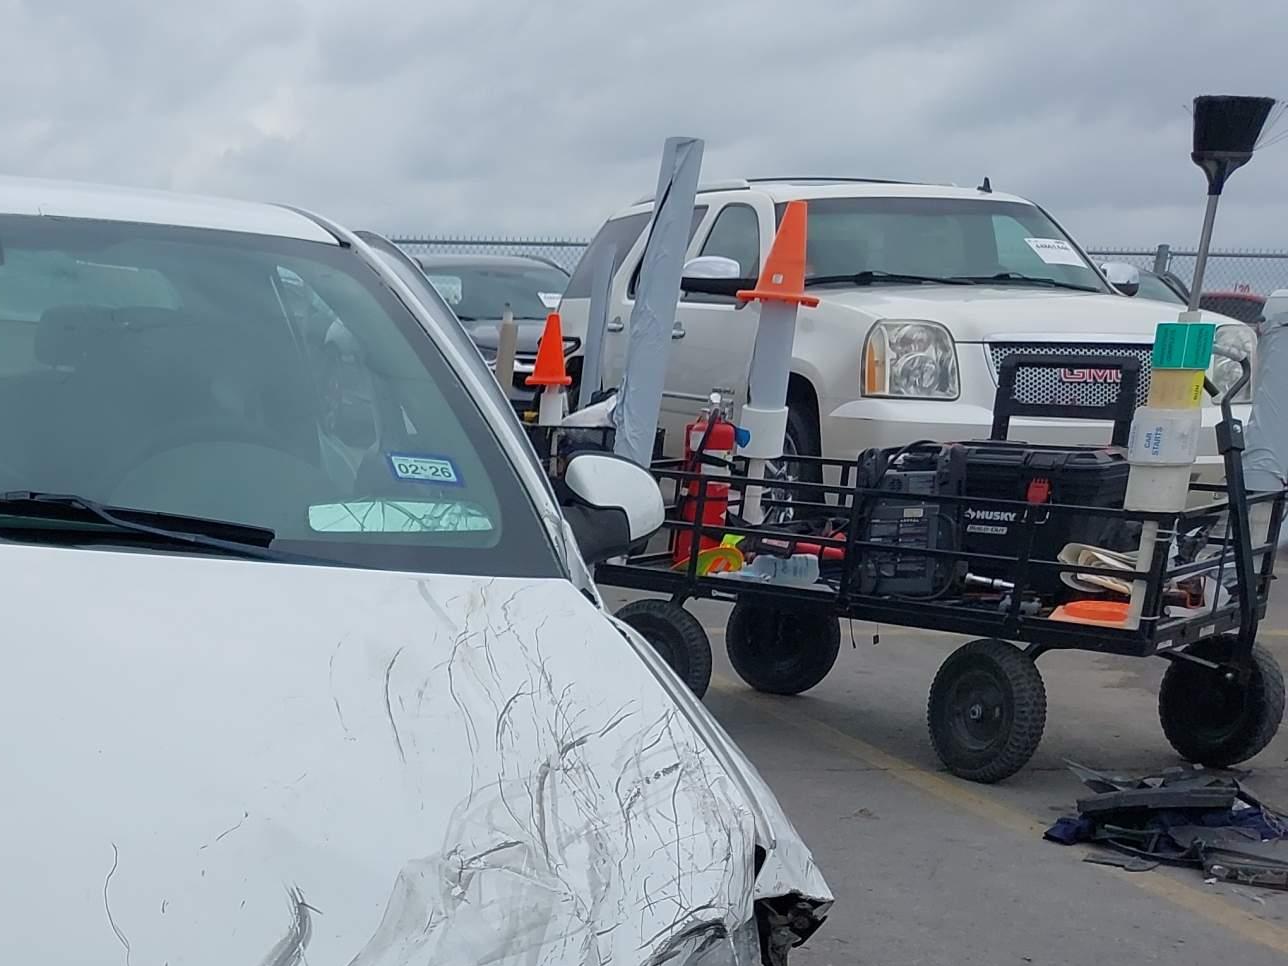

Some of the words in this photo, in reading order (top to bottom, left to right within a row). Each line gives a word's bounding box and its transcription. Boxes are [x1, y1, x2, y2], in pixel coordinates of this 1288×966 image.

[398, 463, 421, 475] 02
[429, 466, 452, 478] 26
[975, 510, 1017, 522] HUSKY
